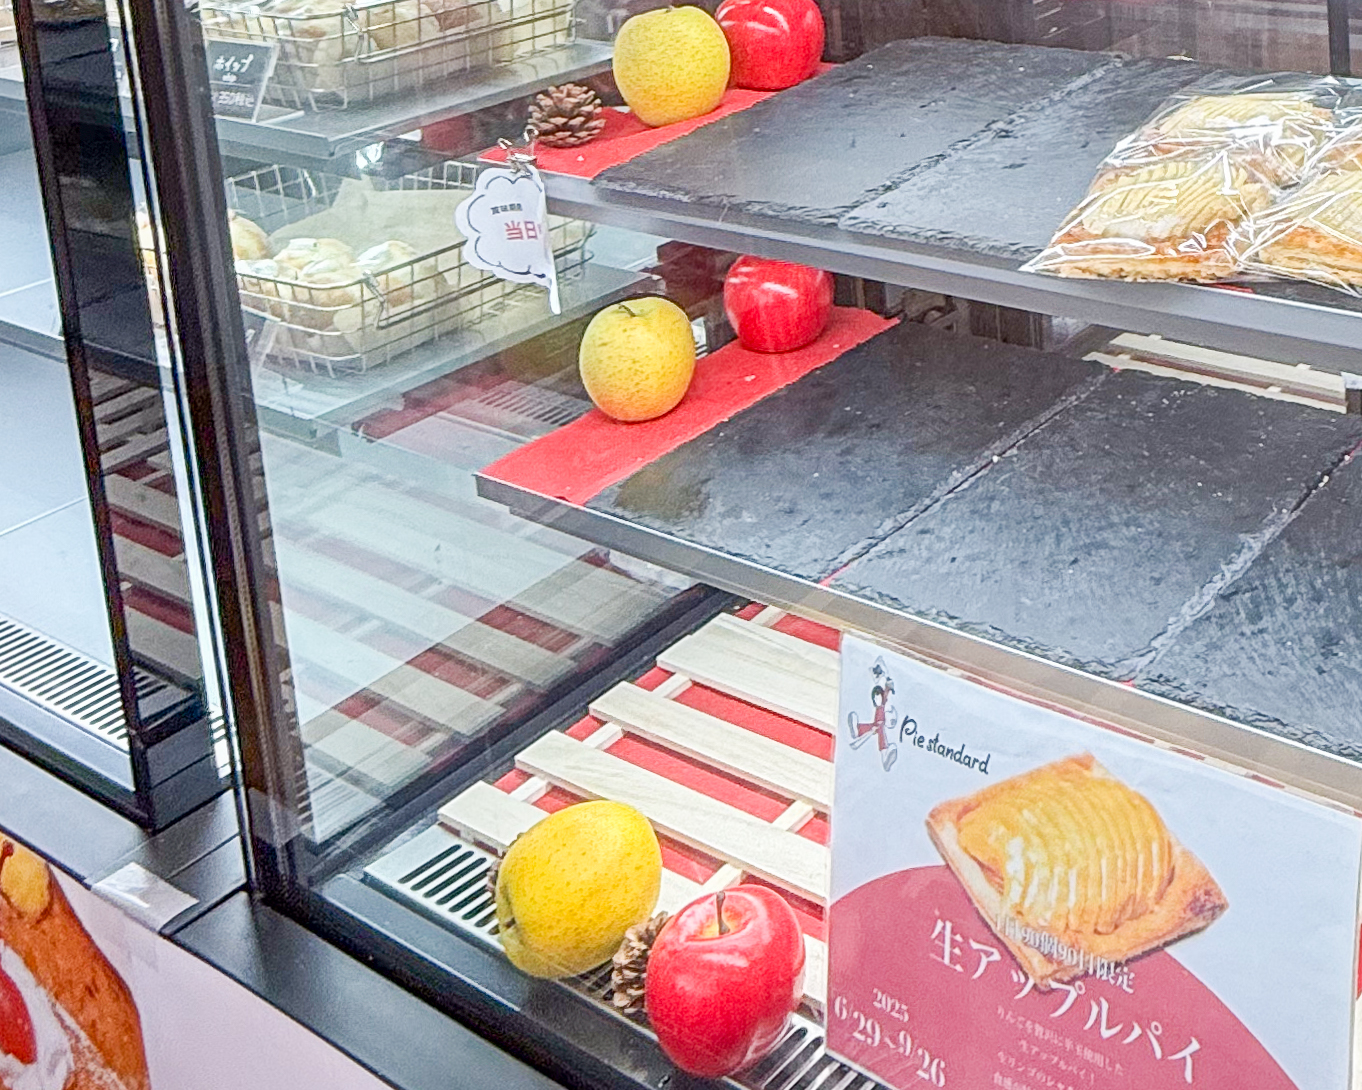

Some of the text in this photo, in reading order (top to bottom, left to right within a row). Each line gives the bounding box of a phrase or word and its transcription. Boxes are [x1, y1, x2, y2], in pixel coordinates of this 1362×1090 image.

[504, 220, 541, 241] 当日
[899, 715, 991, 775] Pie standard
[873, 988, 909, 1023] 2025
[930, 915, 1202, 1085] 生アップルパイ
